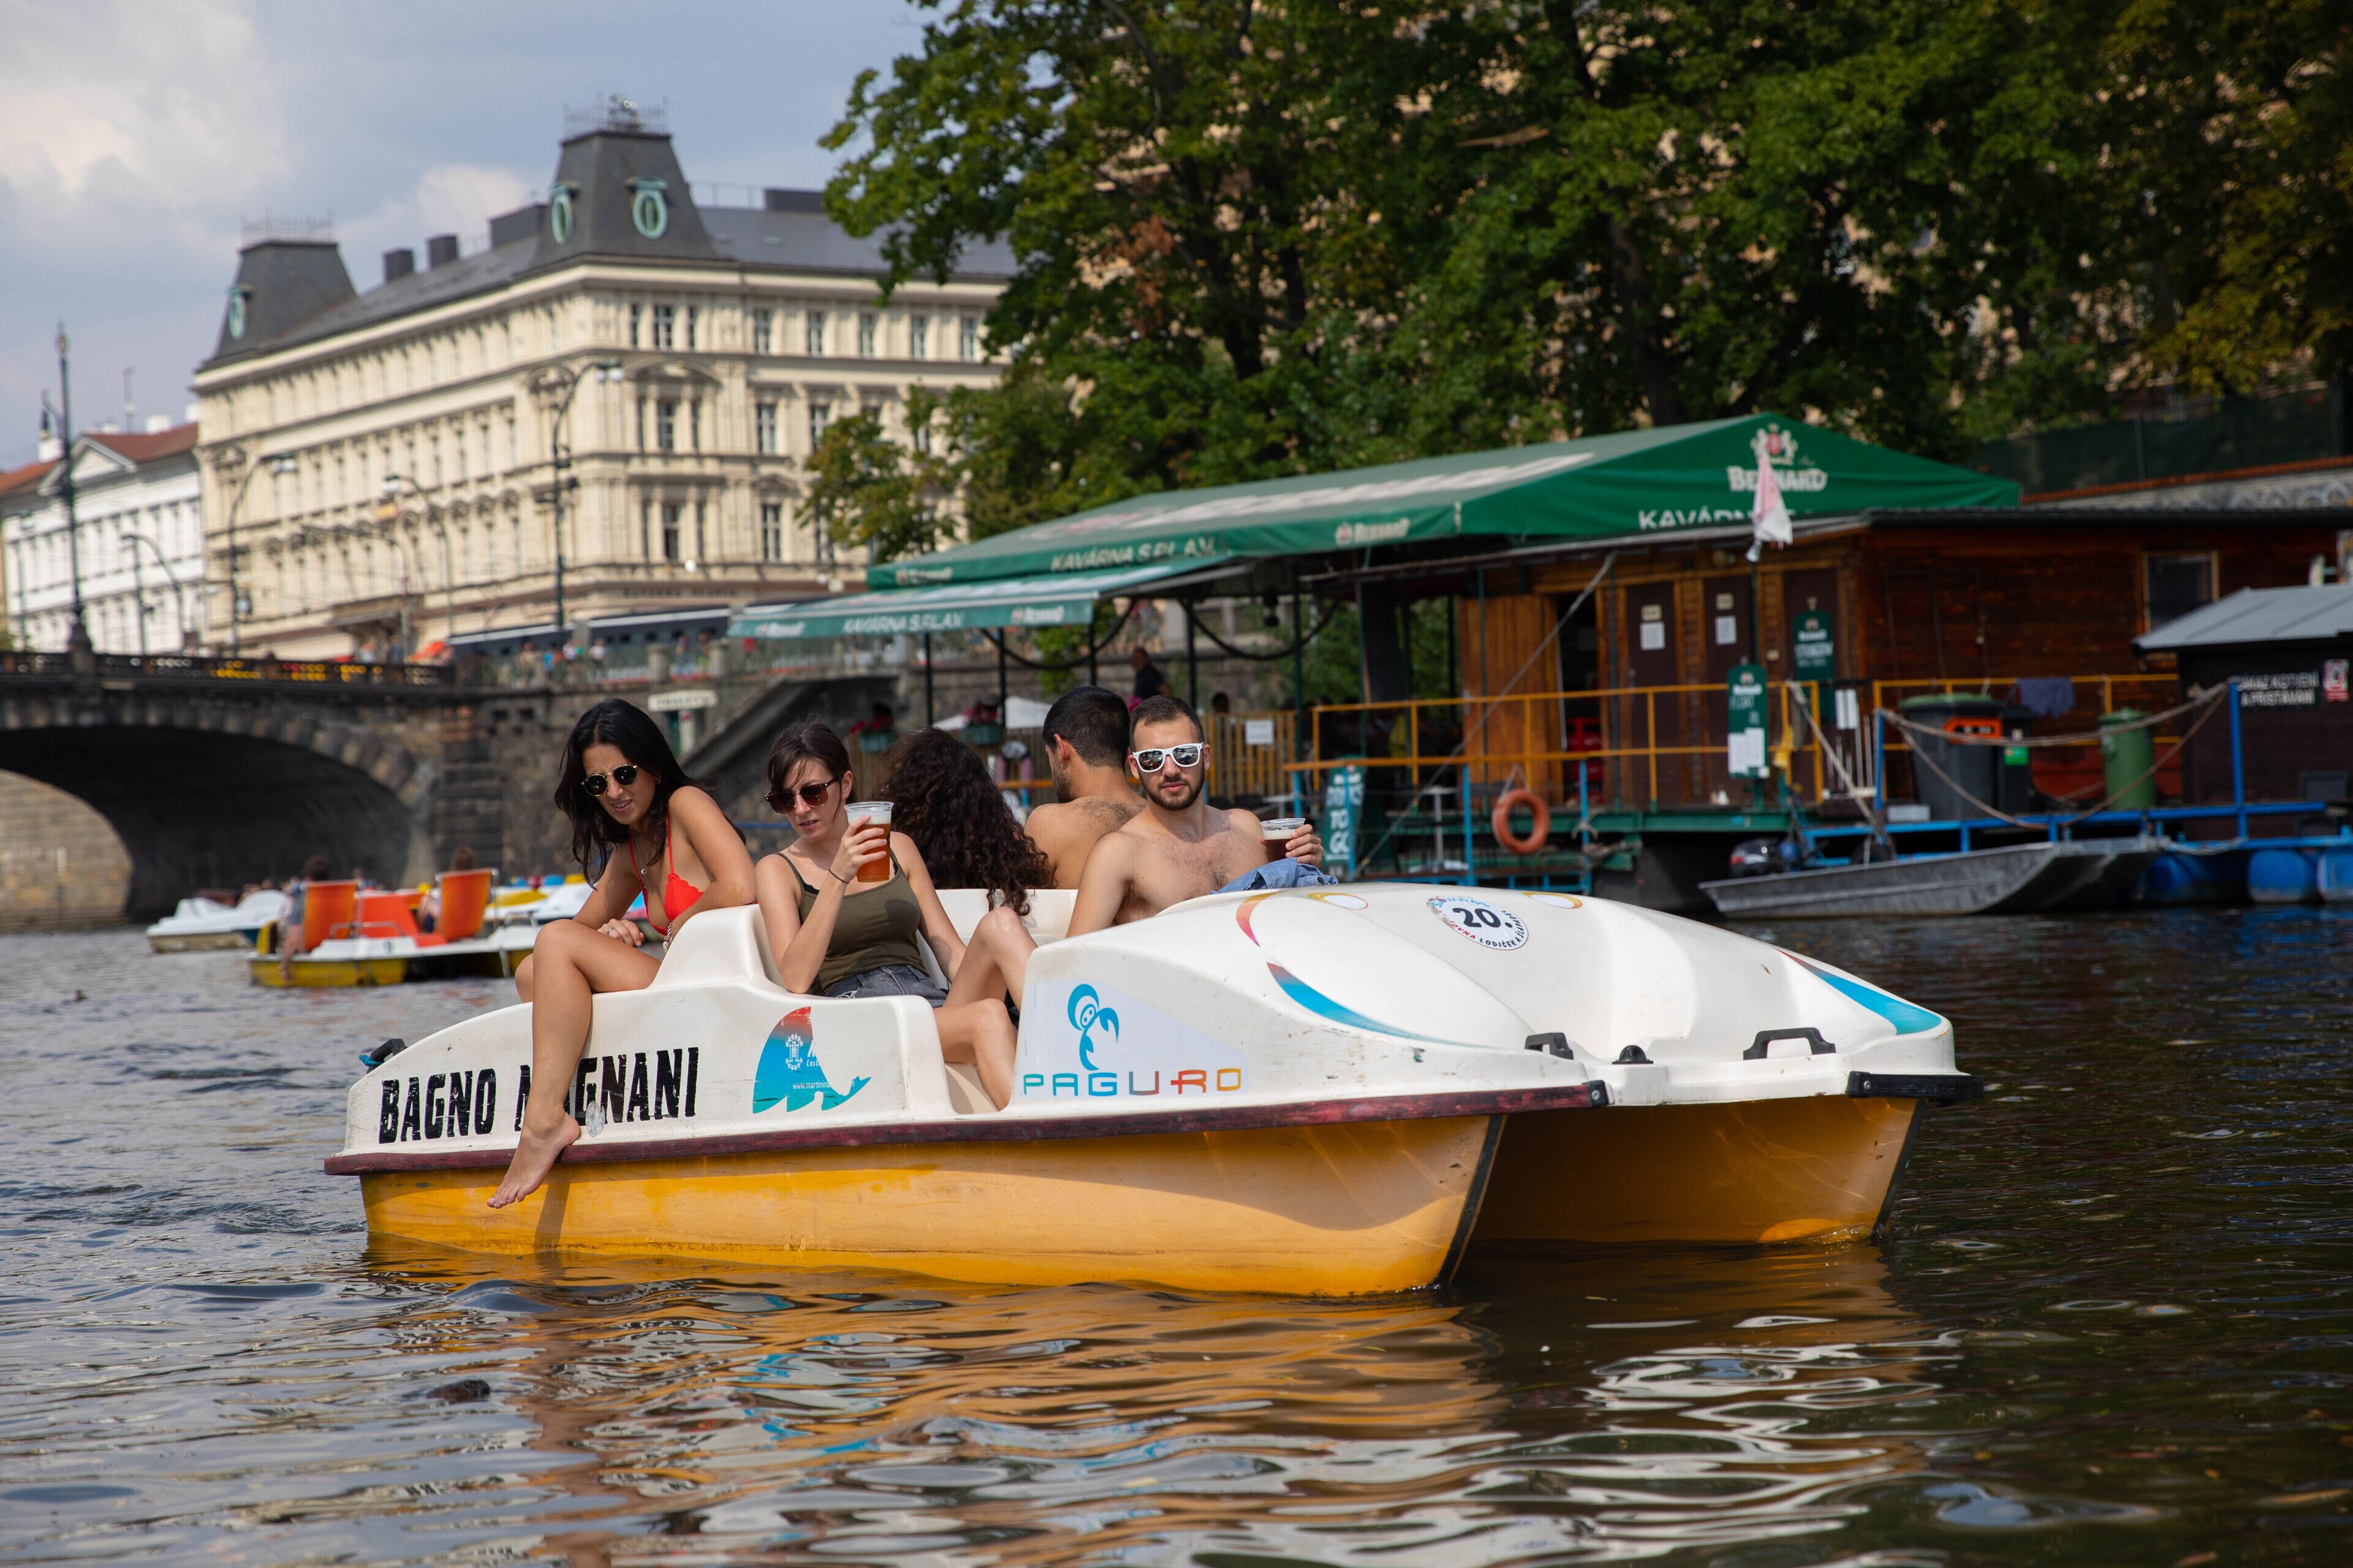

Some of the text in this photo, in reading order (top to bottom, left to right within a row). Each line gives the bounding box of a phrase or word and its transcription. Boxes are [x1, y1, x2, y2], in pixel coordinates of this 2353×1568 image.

[378, 1047, 699, 1144] BAGNO MGNANI
[1023, 1068, 1241, 1097] PAGURO
